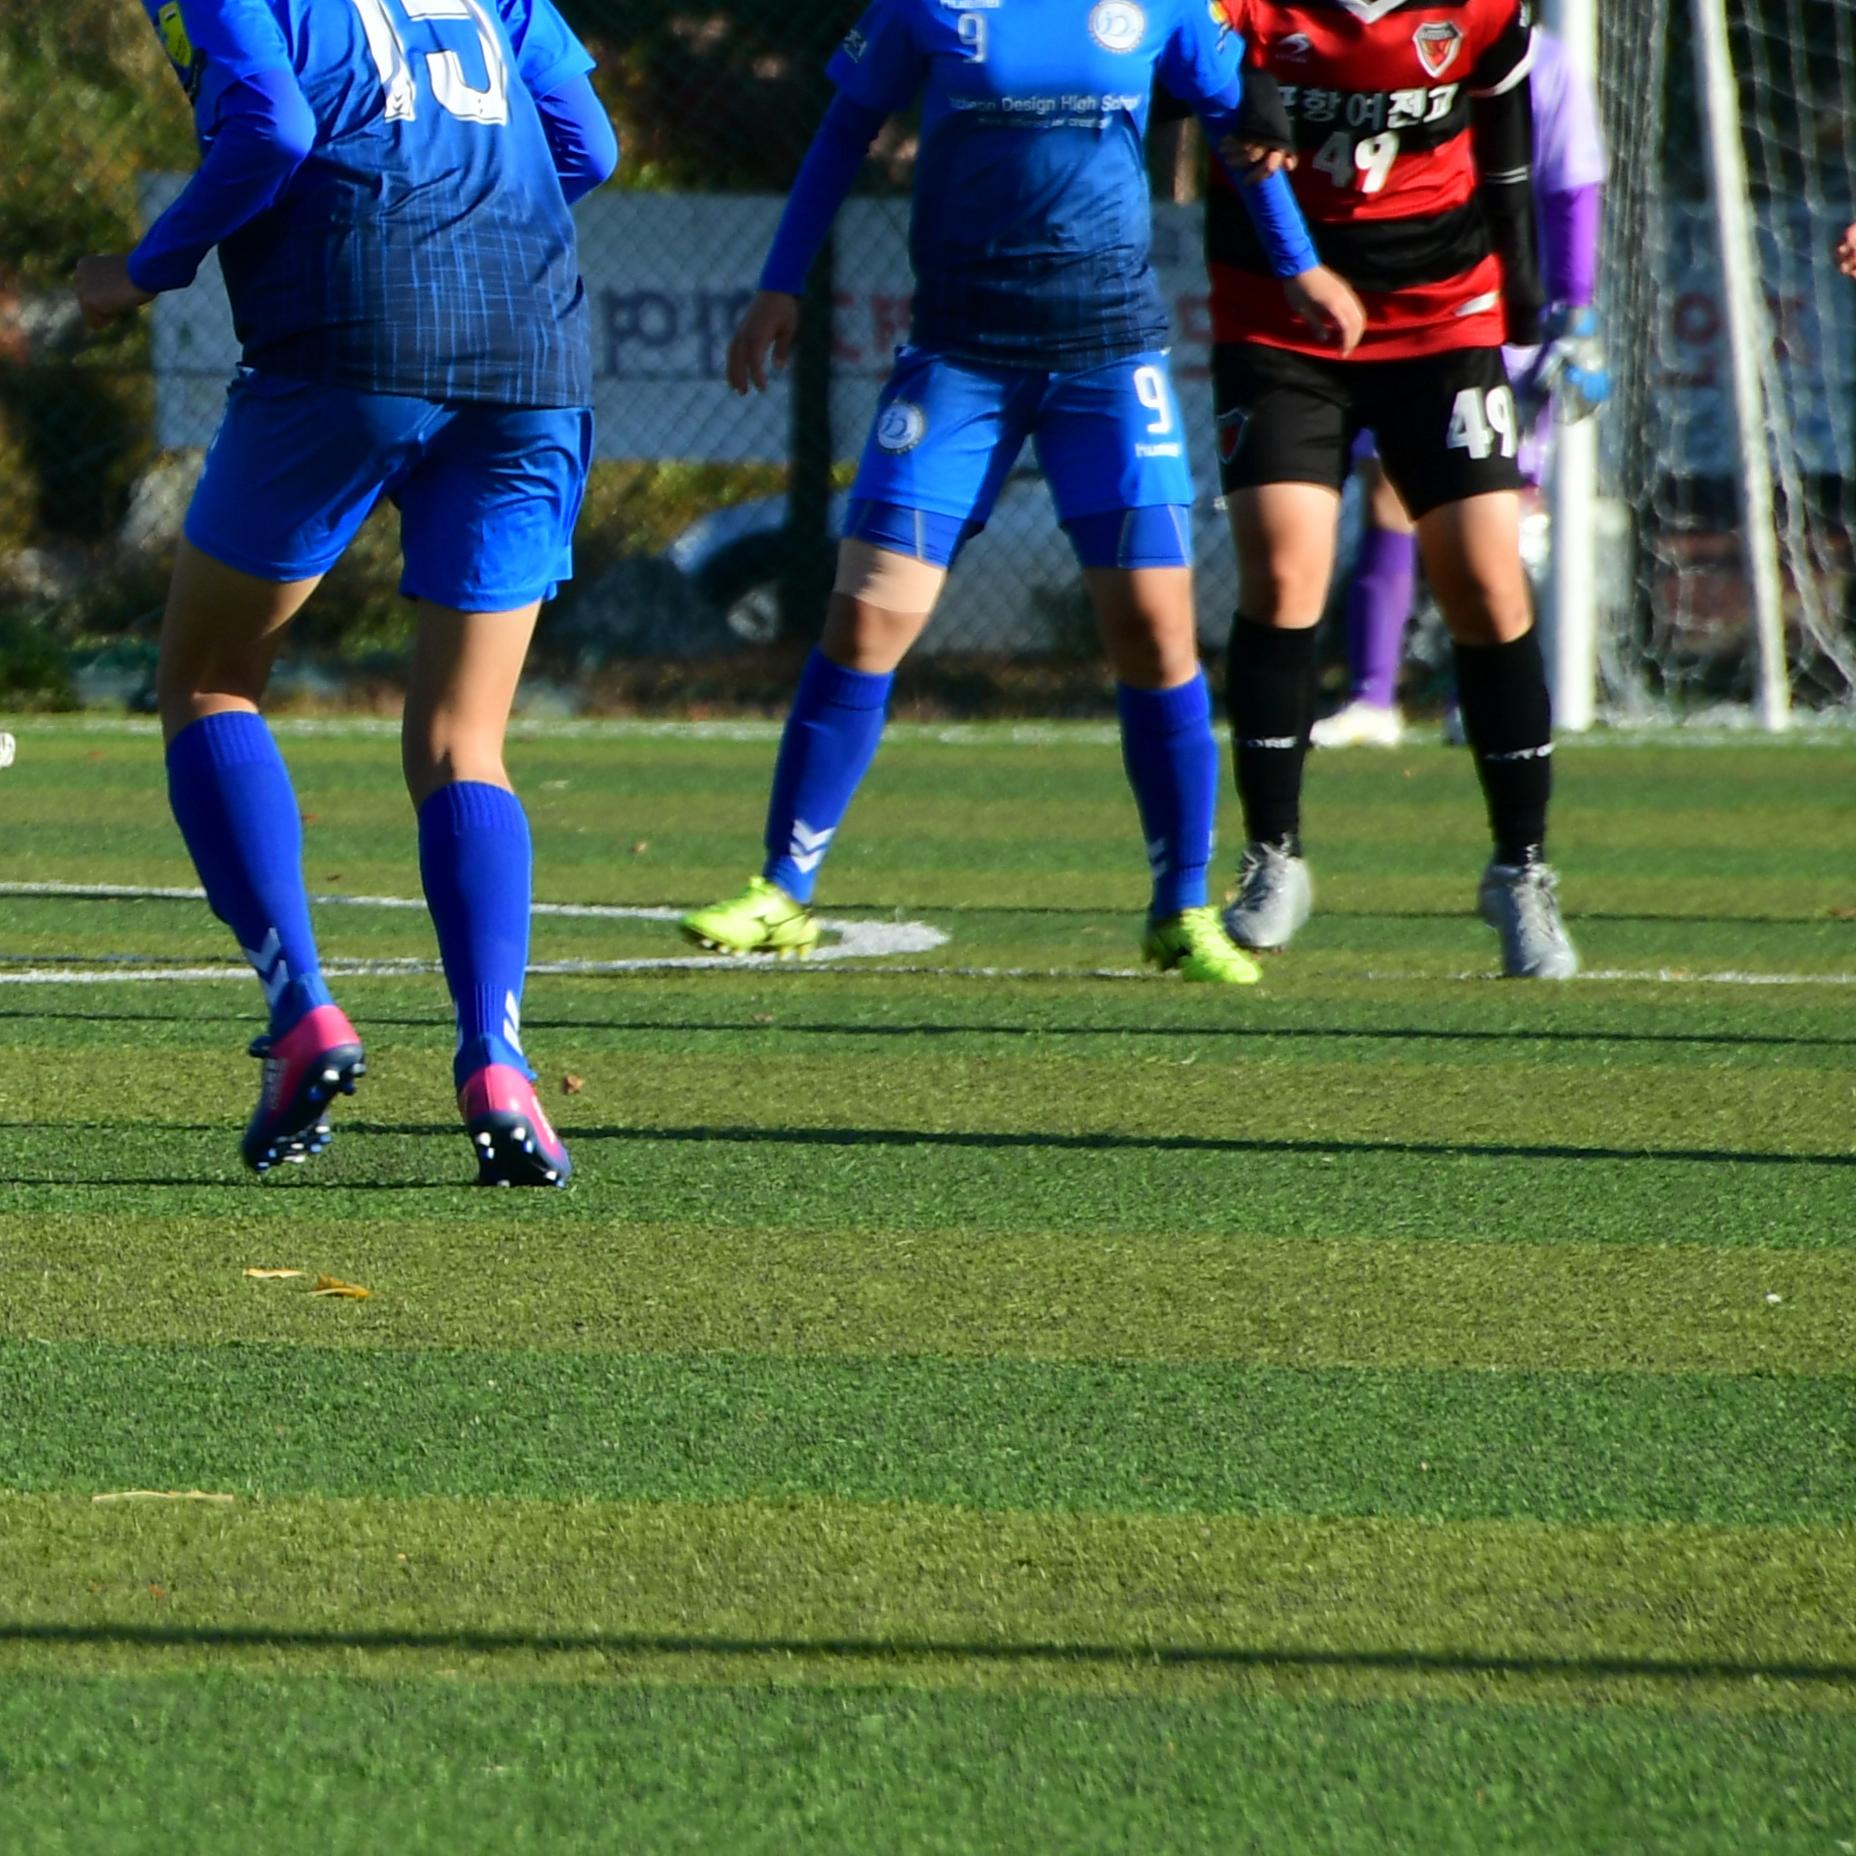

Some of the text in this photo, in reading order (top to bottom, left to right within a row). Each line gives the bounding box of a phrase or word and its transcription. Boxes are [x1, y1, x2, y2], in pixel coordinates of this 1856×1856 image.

[956, 11, 987, 63] 9
[1002, 97, 1056, 115] Design
[1060, 95, 1097, 113] High
[1311, 129, 1401, 194] 49
[1133, 365, 1171, 434] 9
[1446, 387, 1515, 461] 49
